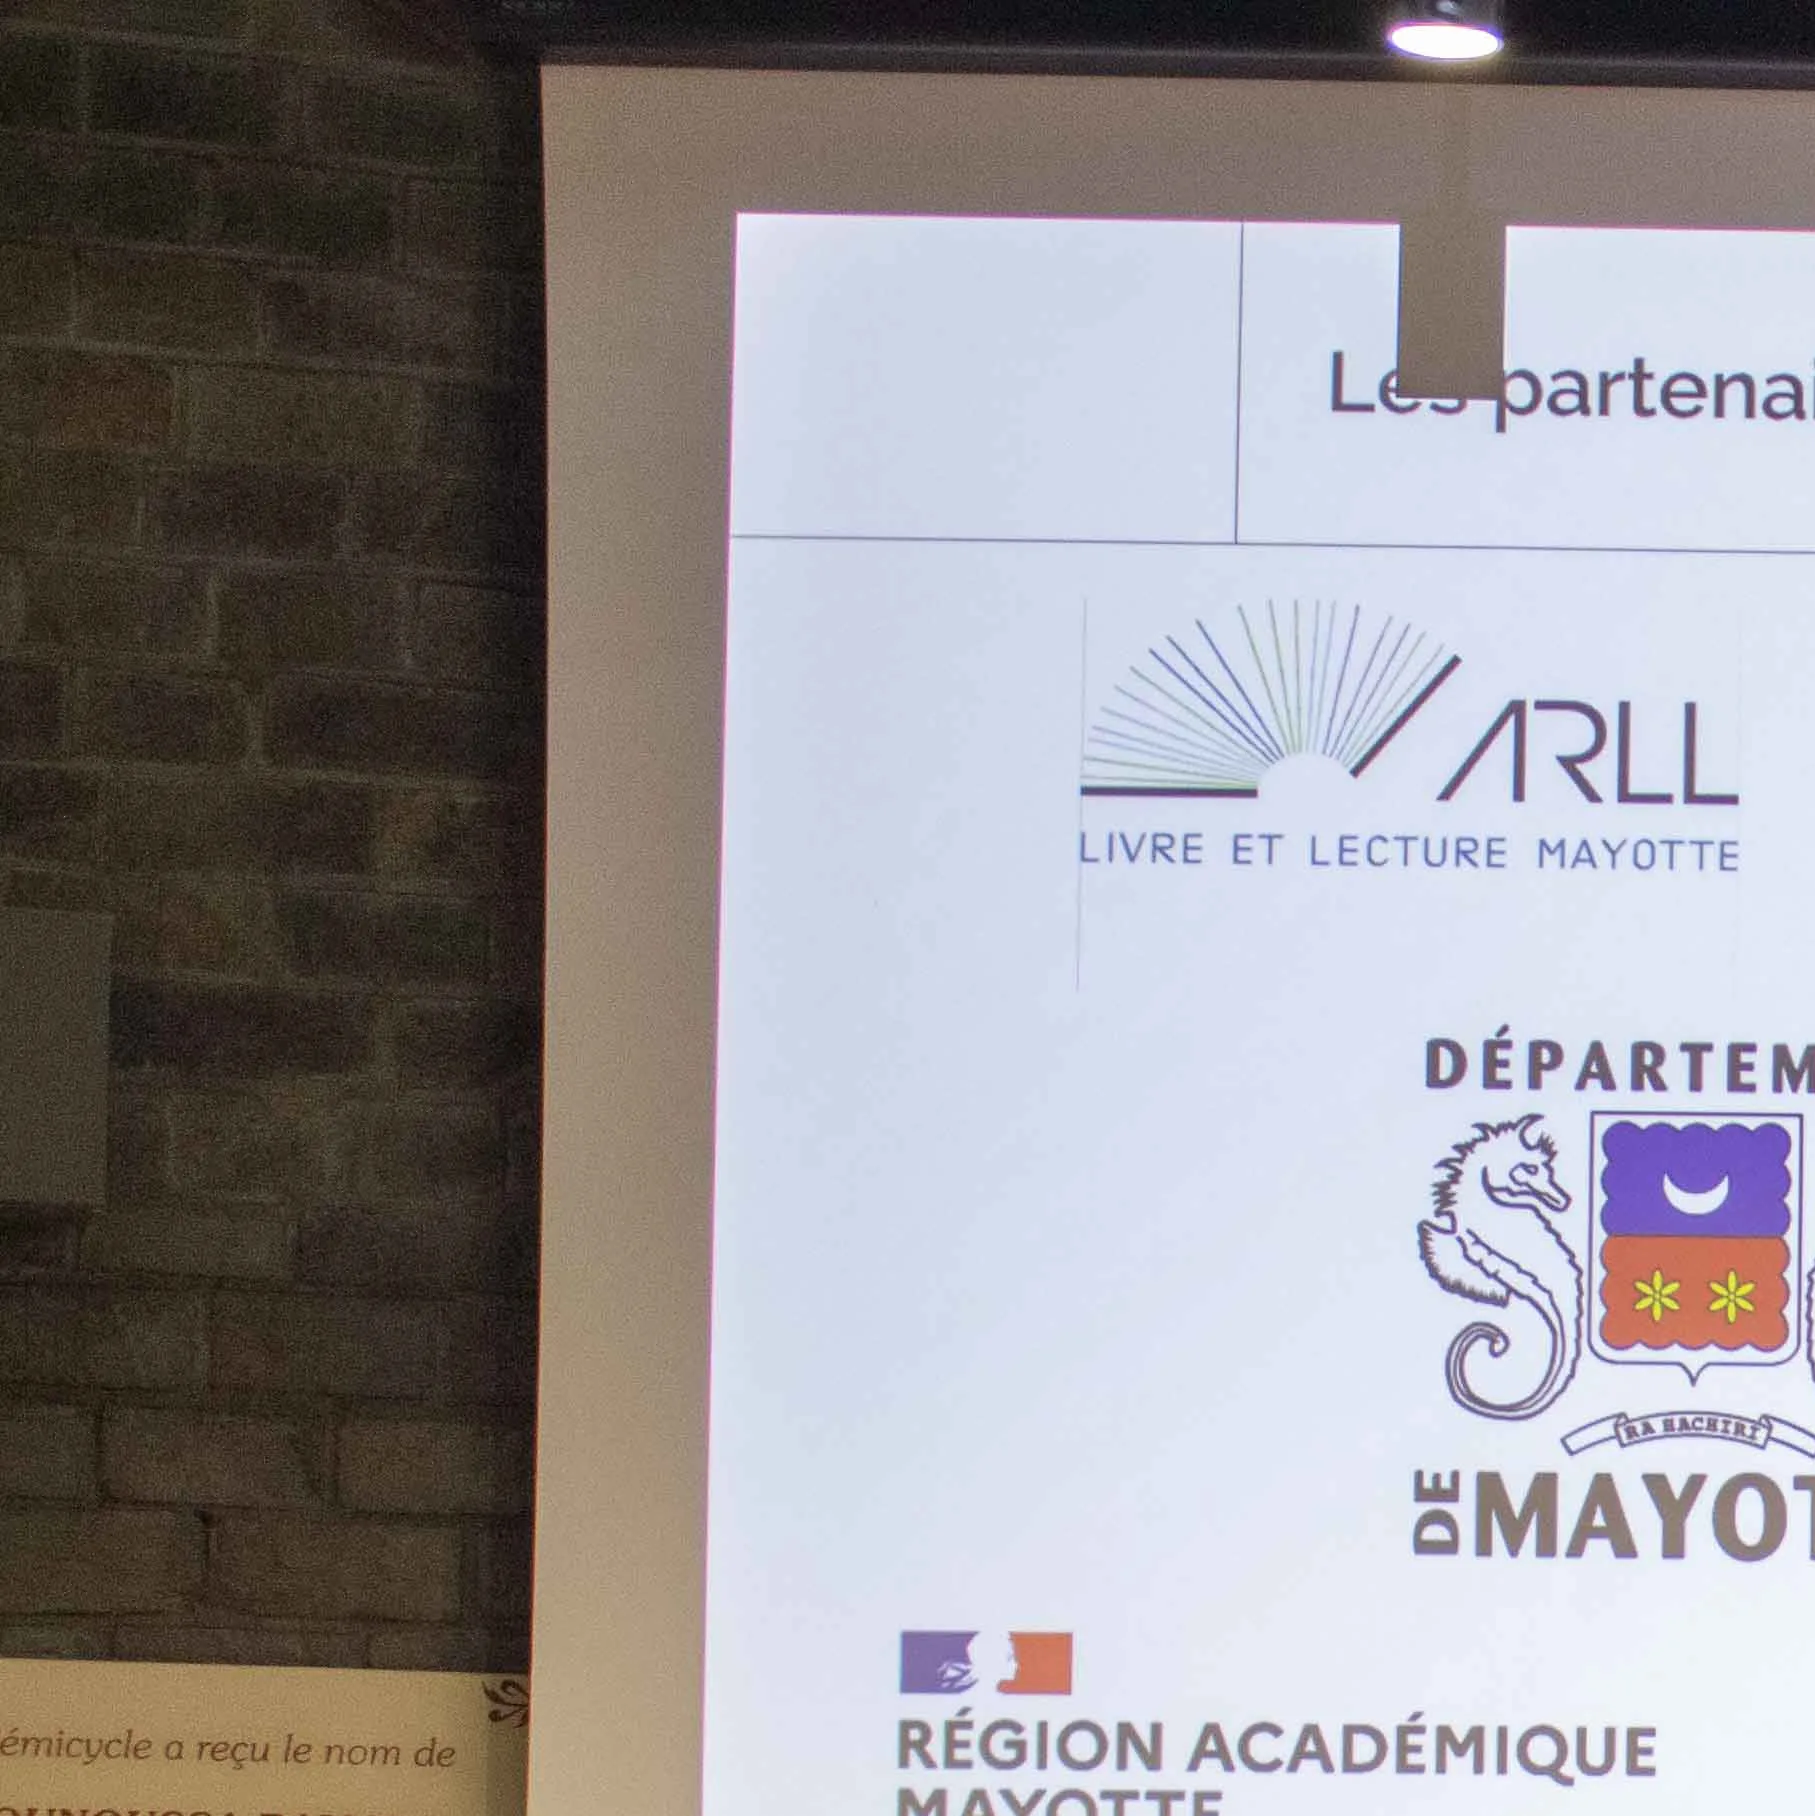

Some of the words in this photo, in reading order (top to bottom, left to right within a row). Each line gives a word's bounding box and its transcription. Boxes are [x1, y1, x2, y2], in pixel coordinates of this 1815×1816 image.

[1437, 700, 1739, 805] ARLL
[1080, 832, 1202, 864] LIVRE
[1233, 834, 1283, 864] ET
[1311, 835, 1505, 868] LECTURE
[1539, 838, 1738, 871] MAYOTTE
[1625, 1421, 1656, 1439] RA
[1663, 1417, 1760, 1441] HACHIRI
[1413, 1470, 1459, 1555] DE
[0, 1727, 152, 1765] émicycle
[165, 1740, 183, 1760] a
[198, 1741, 269, 1770] reçu
[284, 1734, 312, 1764] le
[325, 1745, 401, 1765] nom
[414, 1737, 456, 1767] de
[899, 1707, 1162, 1771] RÉGION
[1187, 1712, 1656, 1786] ACADÉMIQUE
